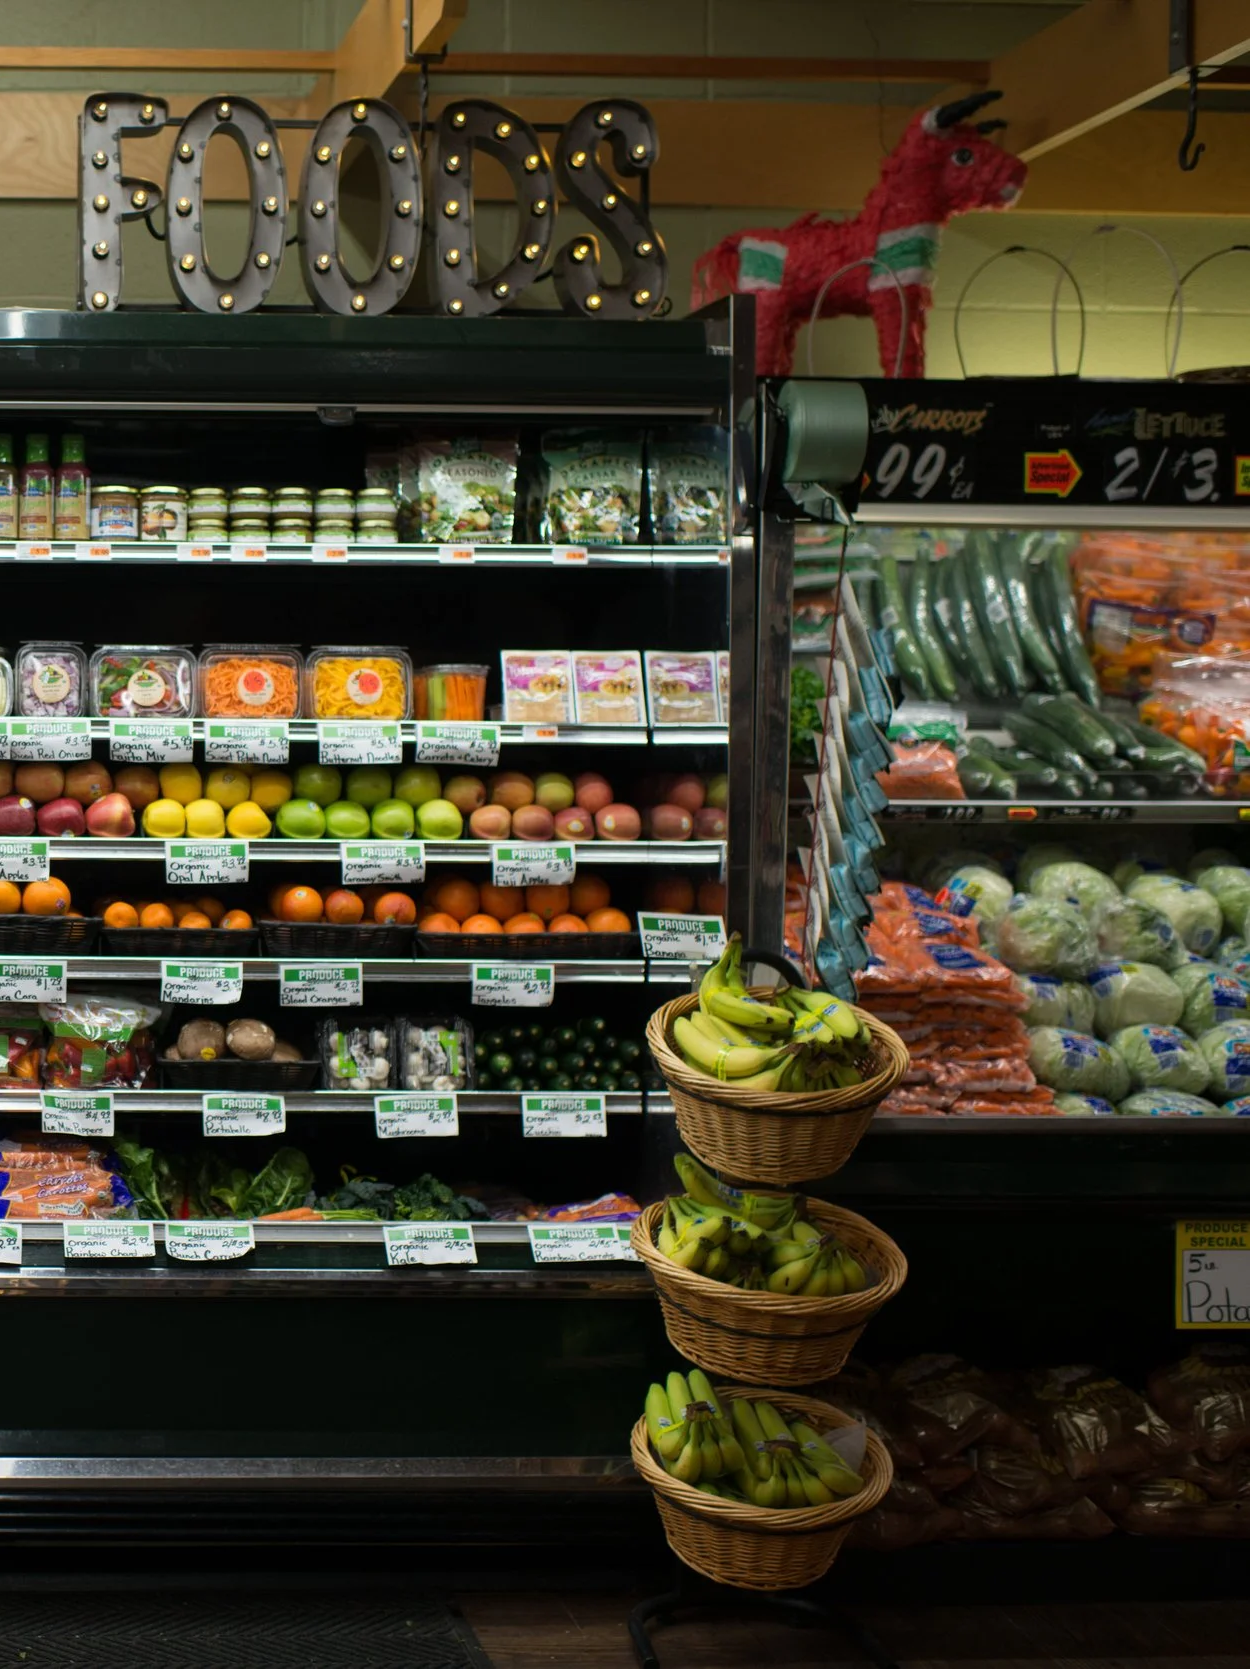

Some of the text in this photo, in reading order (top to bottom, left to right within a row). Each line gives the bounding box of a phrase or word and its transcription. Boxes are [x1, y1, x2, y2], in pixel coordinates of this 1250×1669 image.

[76, 91, 669, 318] FOODS
[1133, 405, 1228, 440] LETTUCE
[1030, 469, 1070, 485] Special
[38, 749, 55, 759] Red
[146, 751, 166, 761] Mix
[0, 868, 29, 880] Apples
[199, 870, 230, 882] Apples
[658, 919, 705, 932] PRODUCE
[2, 965, 49, 976] PRODUCE
[180, 967, 225, 978] PRODUCE
[299, 968, 345, 980] PRODUCE
[491, 968, 537, 980] PRODUCE
[14, 990, 38, 1000] Cara
[54, 1097, 96, 1109] PRODUCE
[222, 1098, 267, 1109] PRODUCE
[393, 1099, 439, 1111] PRODUCE
[541, 1098, 587, 1110] PRODUCE
[1185, 1222, 1250, 1233] PRODUCE
[1190, 1236, 1247, 1247] SPECIAL
[389, 1250, 418, 1265] Kale
